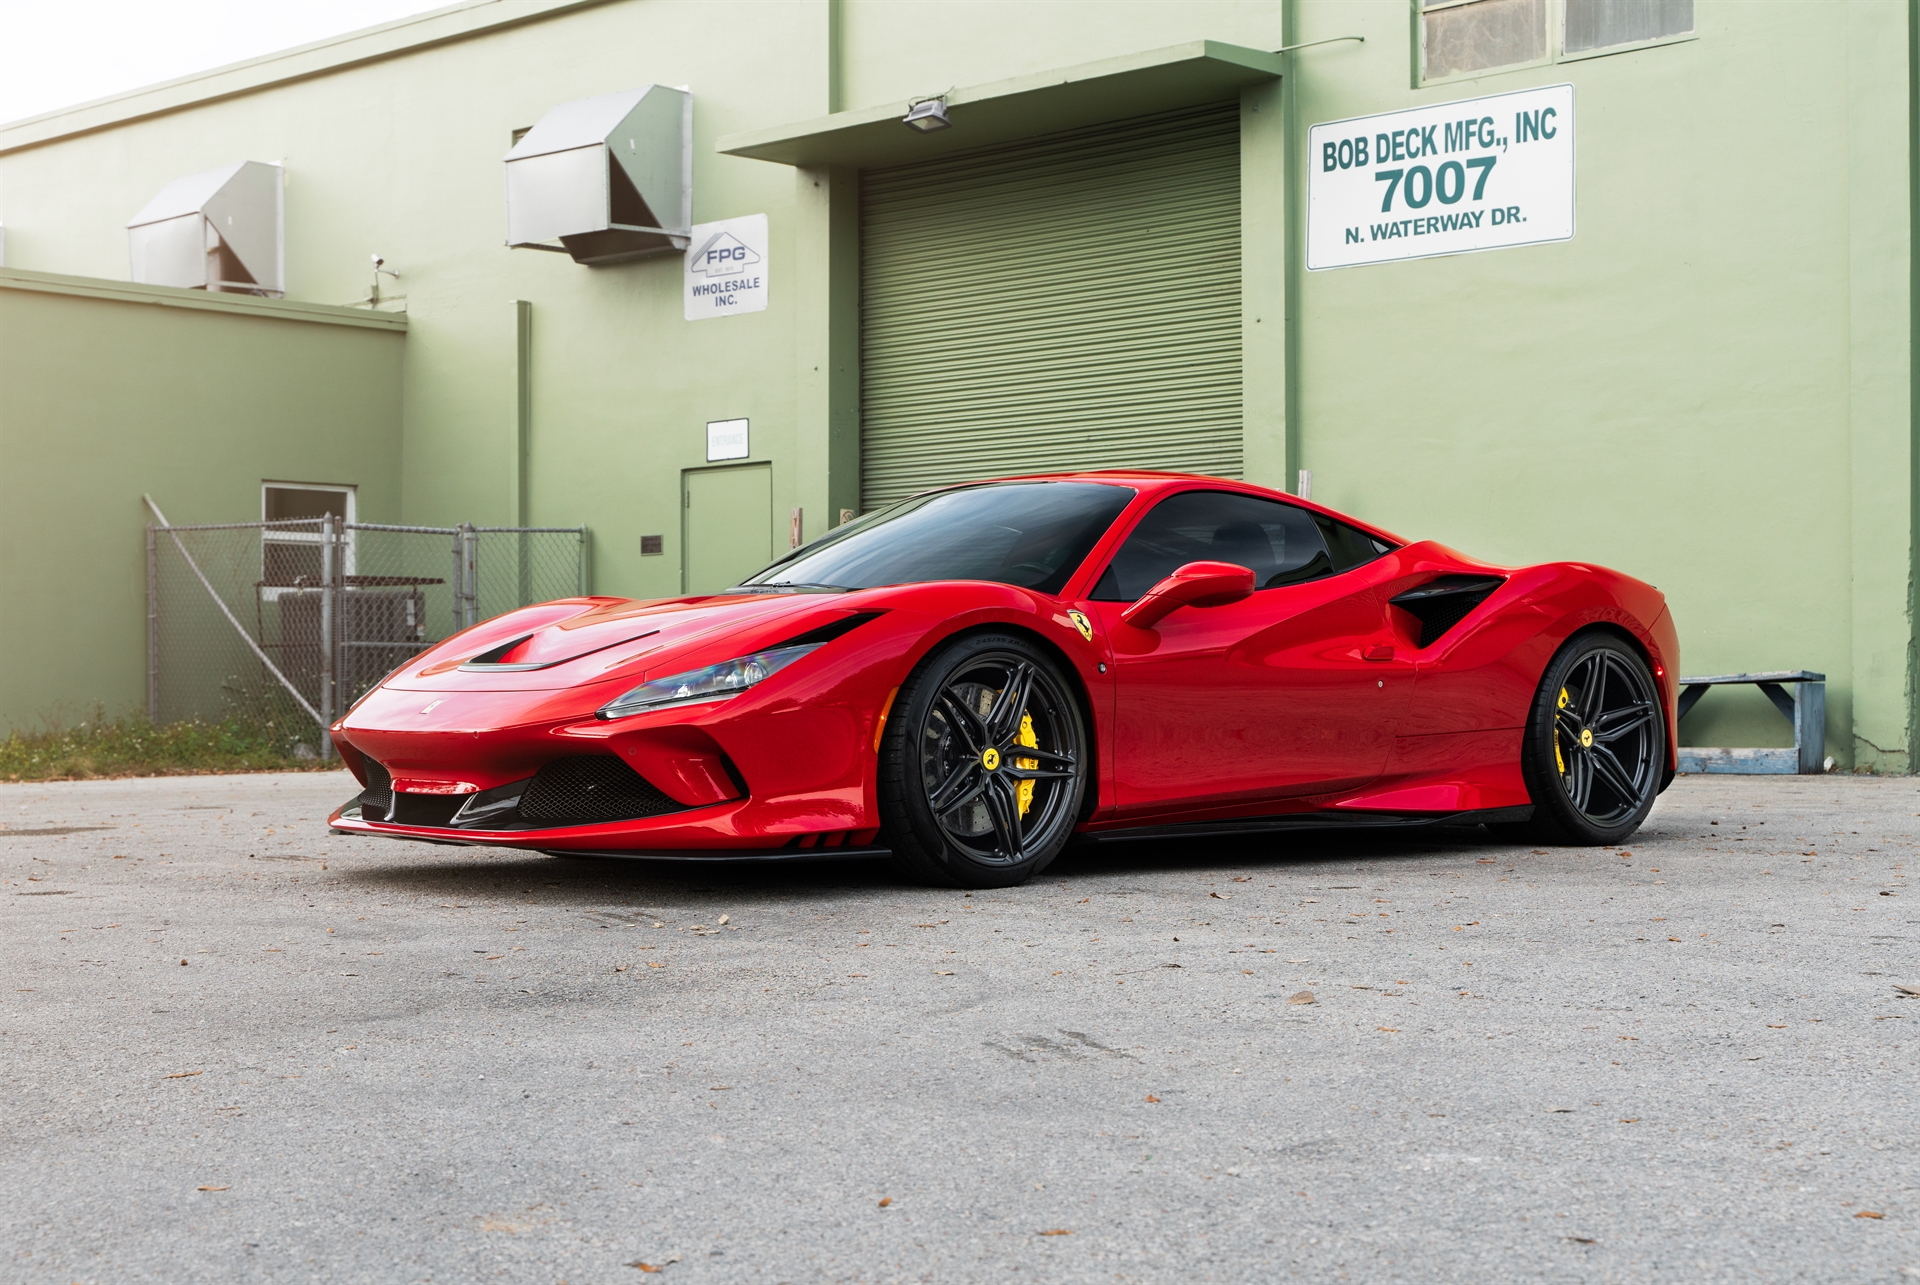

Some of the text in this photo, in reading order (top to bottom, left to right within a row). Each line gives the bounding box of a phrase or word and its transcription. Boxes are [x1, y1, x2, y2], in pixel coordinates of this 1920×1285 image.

[1323, 107, 1557, 172] BOB DECK MFG., INC
[1375, 155, 1497, 213] 7007
[1345, 205, 1528, 245] N. WATERWAY DR.
[707, 246, 746, 264] FPG
[692, 277, 760, 297] WHOLESALE
[715, 294, 738, 307] INC.
[712, 433, 744, 447] ENTRANCE
